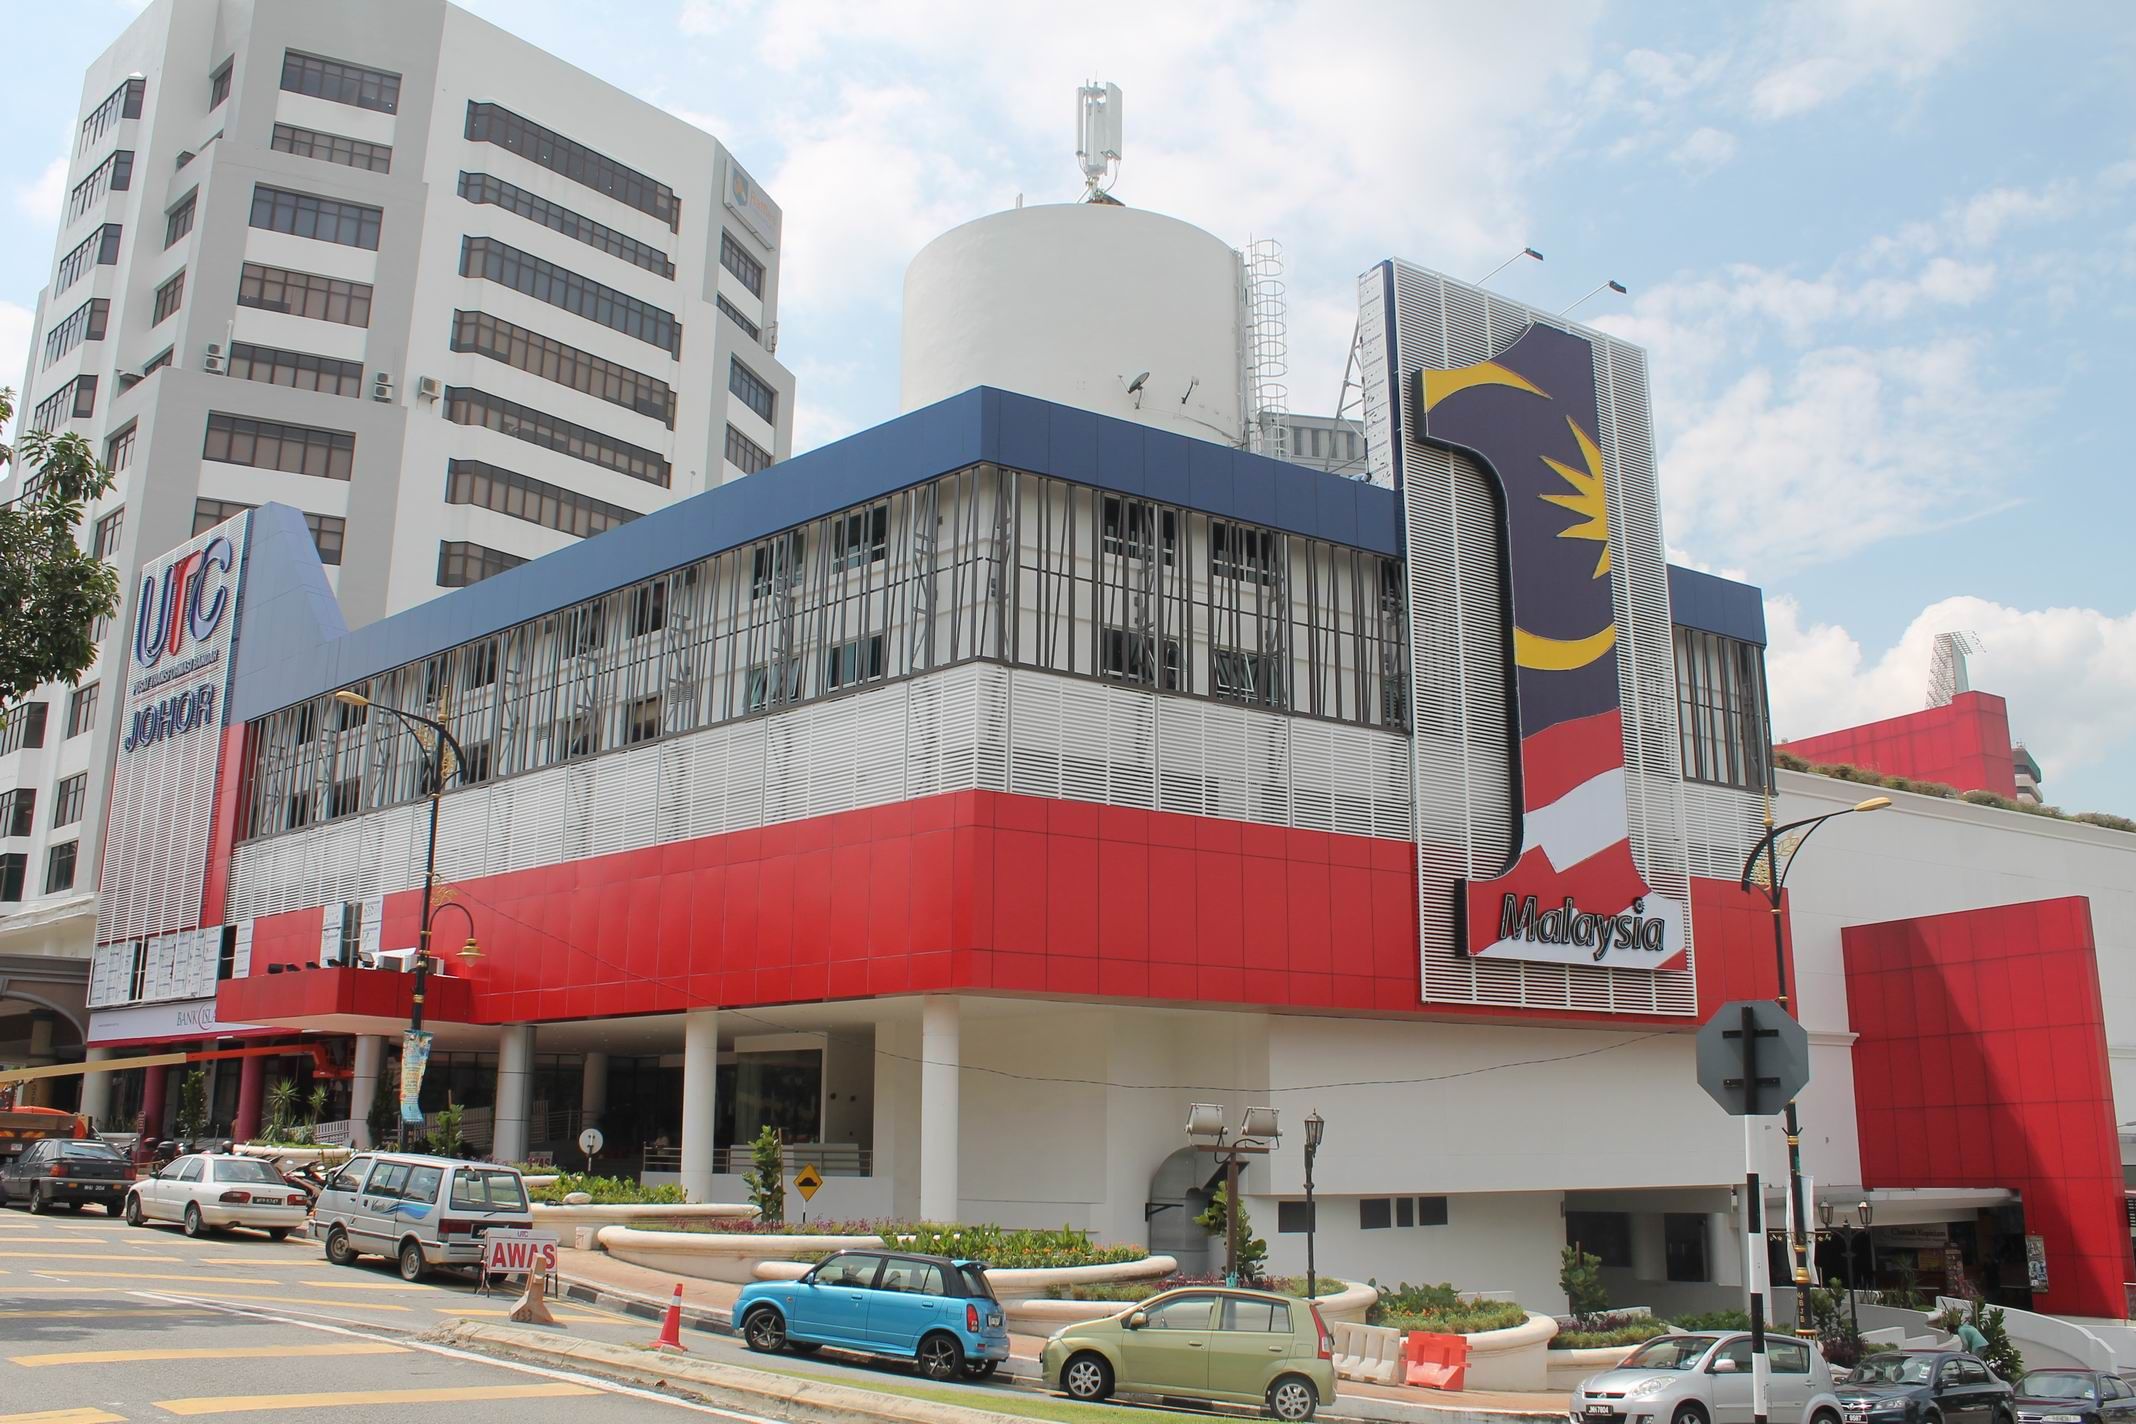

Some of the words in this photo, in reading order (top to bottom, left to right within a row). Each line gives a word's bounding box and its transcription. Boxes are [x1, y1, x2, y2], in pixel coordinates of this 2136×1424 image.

[136, 535, 232, 668] UTC
[124, 682, 215, 752] JOHOR
[1499, 892, 1666, 962] Malaysia
[176, 1010, 198, 1026] BANK
[491, 1242, 555, 1269] AWAS
